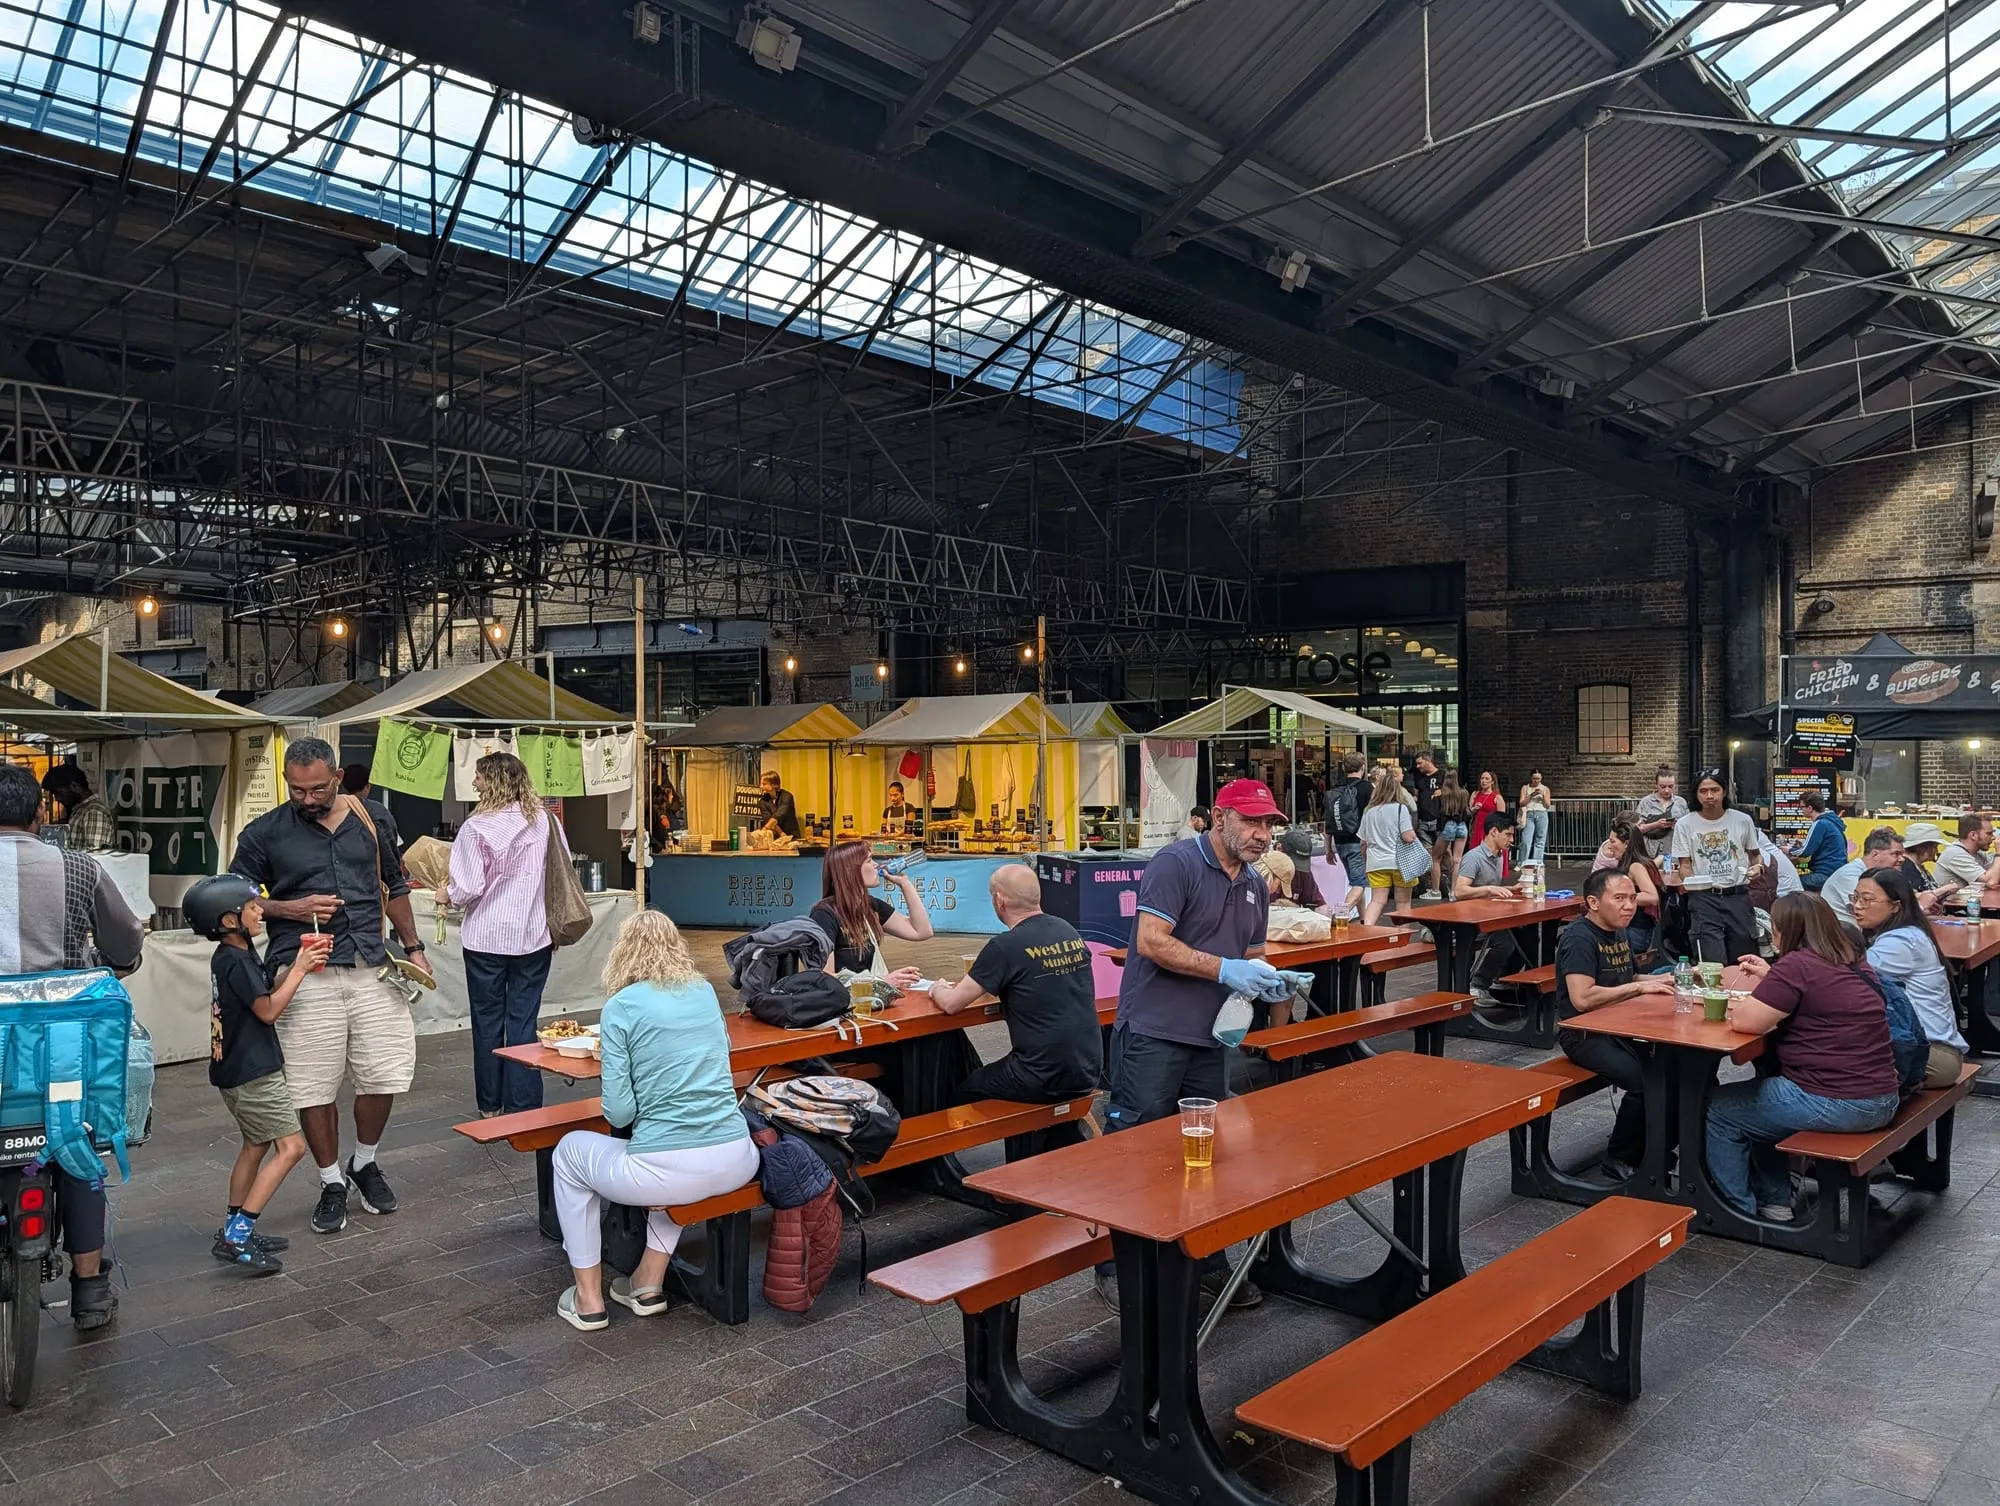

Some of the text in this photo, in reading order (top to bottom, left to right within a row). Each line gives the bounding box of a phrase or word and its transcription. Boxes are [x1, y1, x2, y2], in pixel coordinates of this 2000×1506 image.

[1809, 663, 1853, 684] FRIED
[1795, 674, 1860, 700] CHICKEN
[1866, 674, 1880, 691] &
[1885, 664, 1962, 696] BURGERS
[1967, 671, 1981, 688] &
[244, 755, 270, 766] OYSTERS
[737, 795, 761, 804] FILLIN
[728, 874, 793, 891] BREAD
[1094, 869, 1144, 882] GENERAL W
[884, 876, 957, 892] BEAD
[728, 891, 794, 906] AHEAD
[1024, 937, 1086, 960] West End
[1043, 951, 1083, 968] Musical
[1055, 966, 1077, 976] CHOIR
[4, 1135, 48, 1150] 88MO
[14, 1150, 41, 1160] rentals
